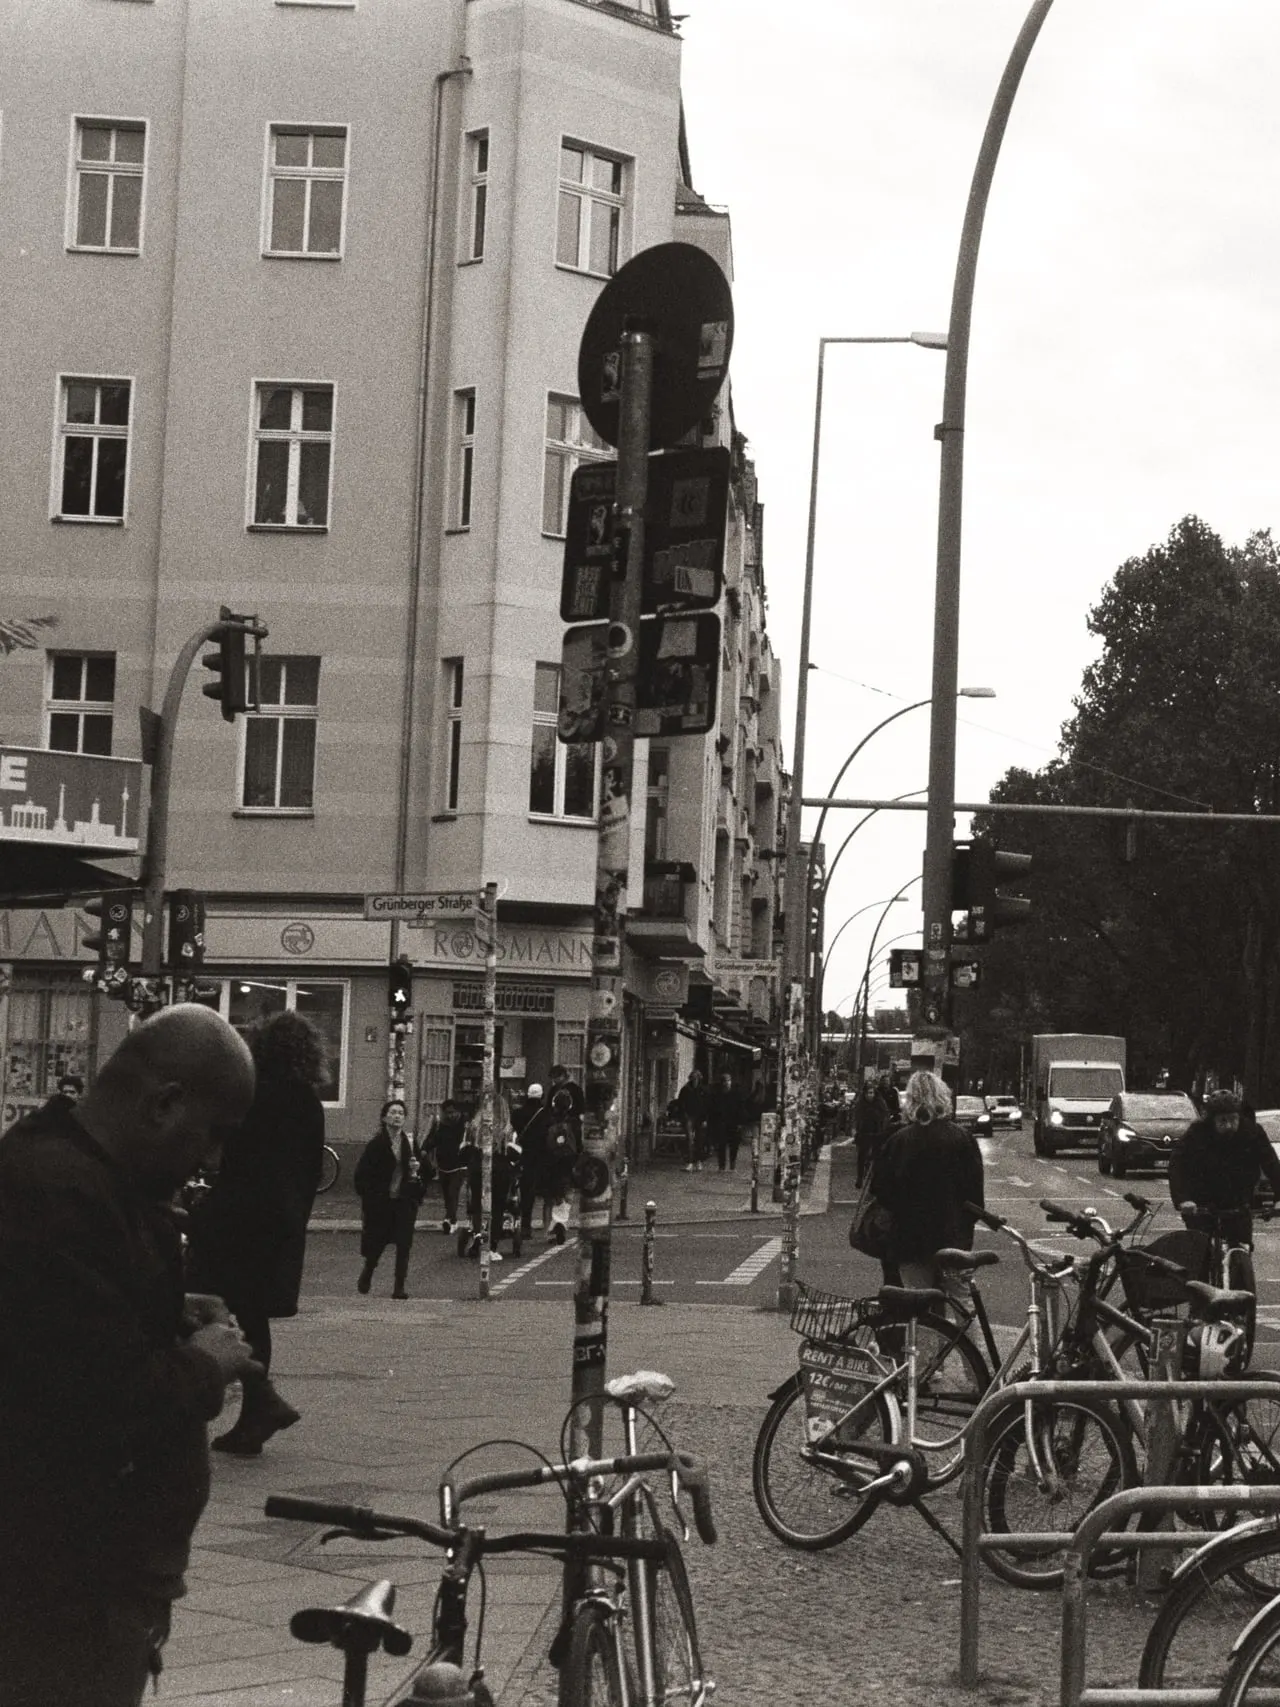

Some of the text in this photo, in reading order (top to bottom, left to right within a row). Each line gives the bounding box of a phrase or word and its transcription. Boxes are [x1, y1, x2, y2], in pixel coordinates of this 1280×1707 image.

[0, 754, 28, 792] E
[373, 895, 473, 913] Grünberger Straße
[803, 1349, 870, 1373] RENT A BIKE
